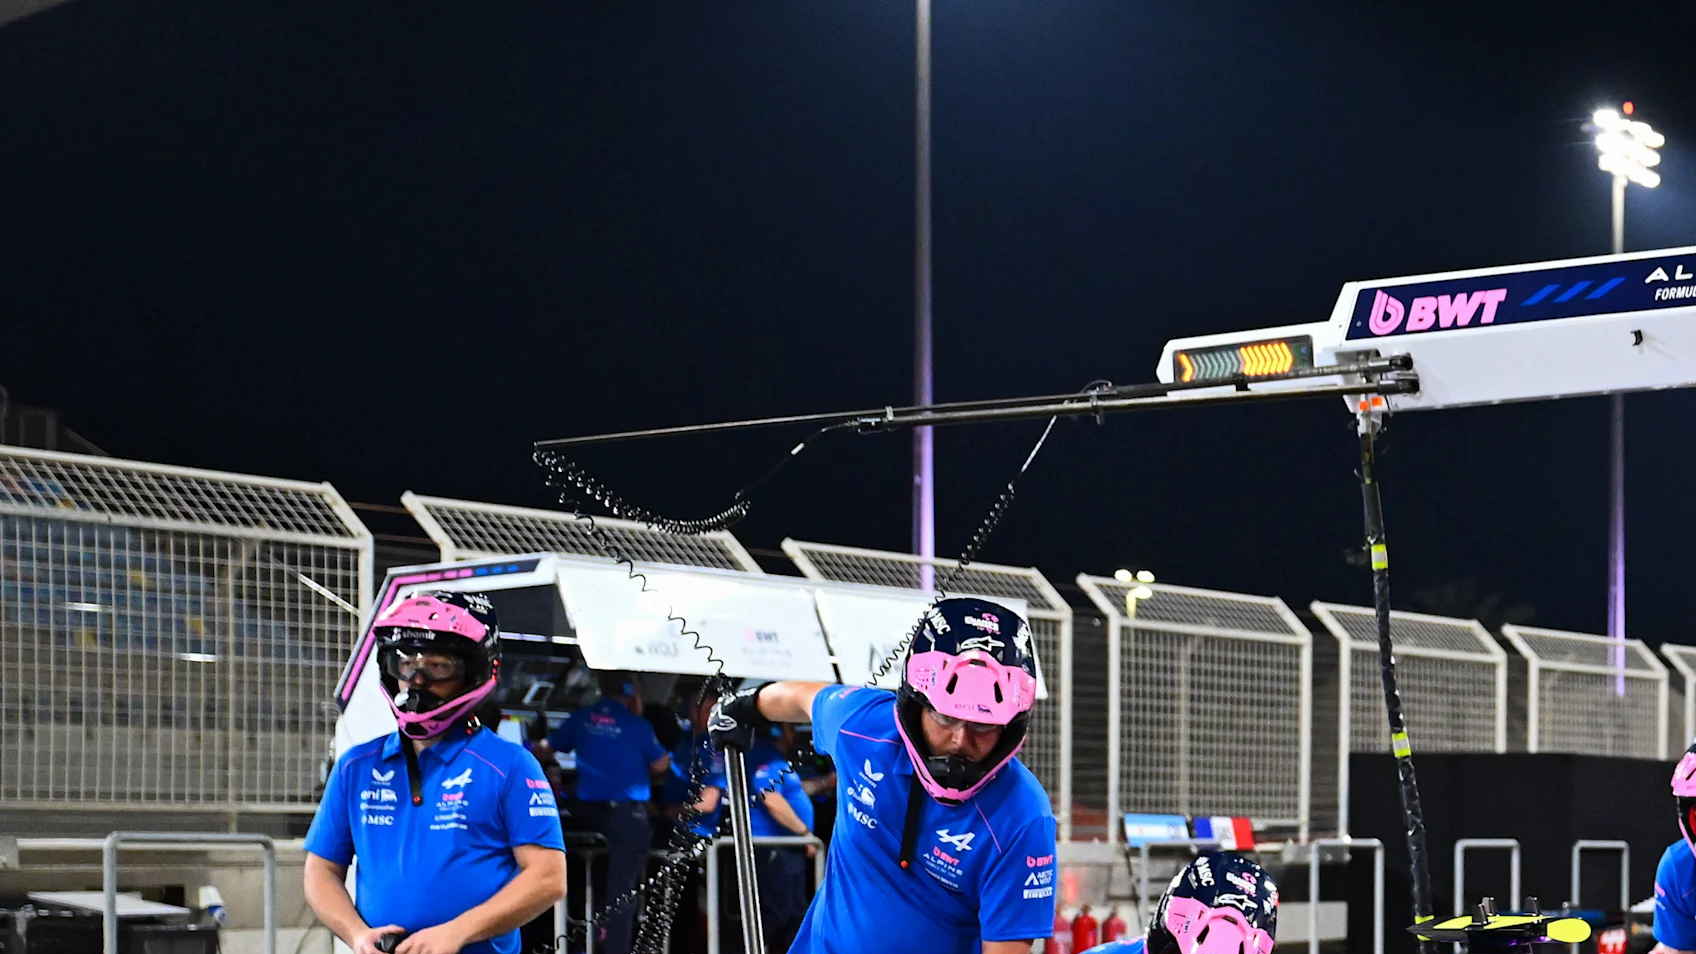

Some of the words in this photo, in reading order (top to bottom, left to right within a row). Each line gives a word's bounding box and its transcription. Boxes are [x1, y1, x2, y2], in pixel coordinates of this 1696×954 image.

[1405, 287, 1507, 332] BWT
[930, 612, 951, 635] MSC
[367, 816, 394, 826] MSC
[853, 806, 878, 829] MSC
[1196, 863, 1215, 887] MSC
